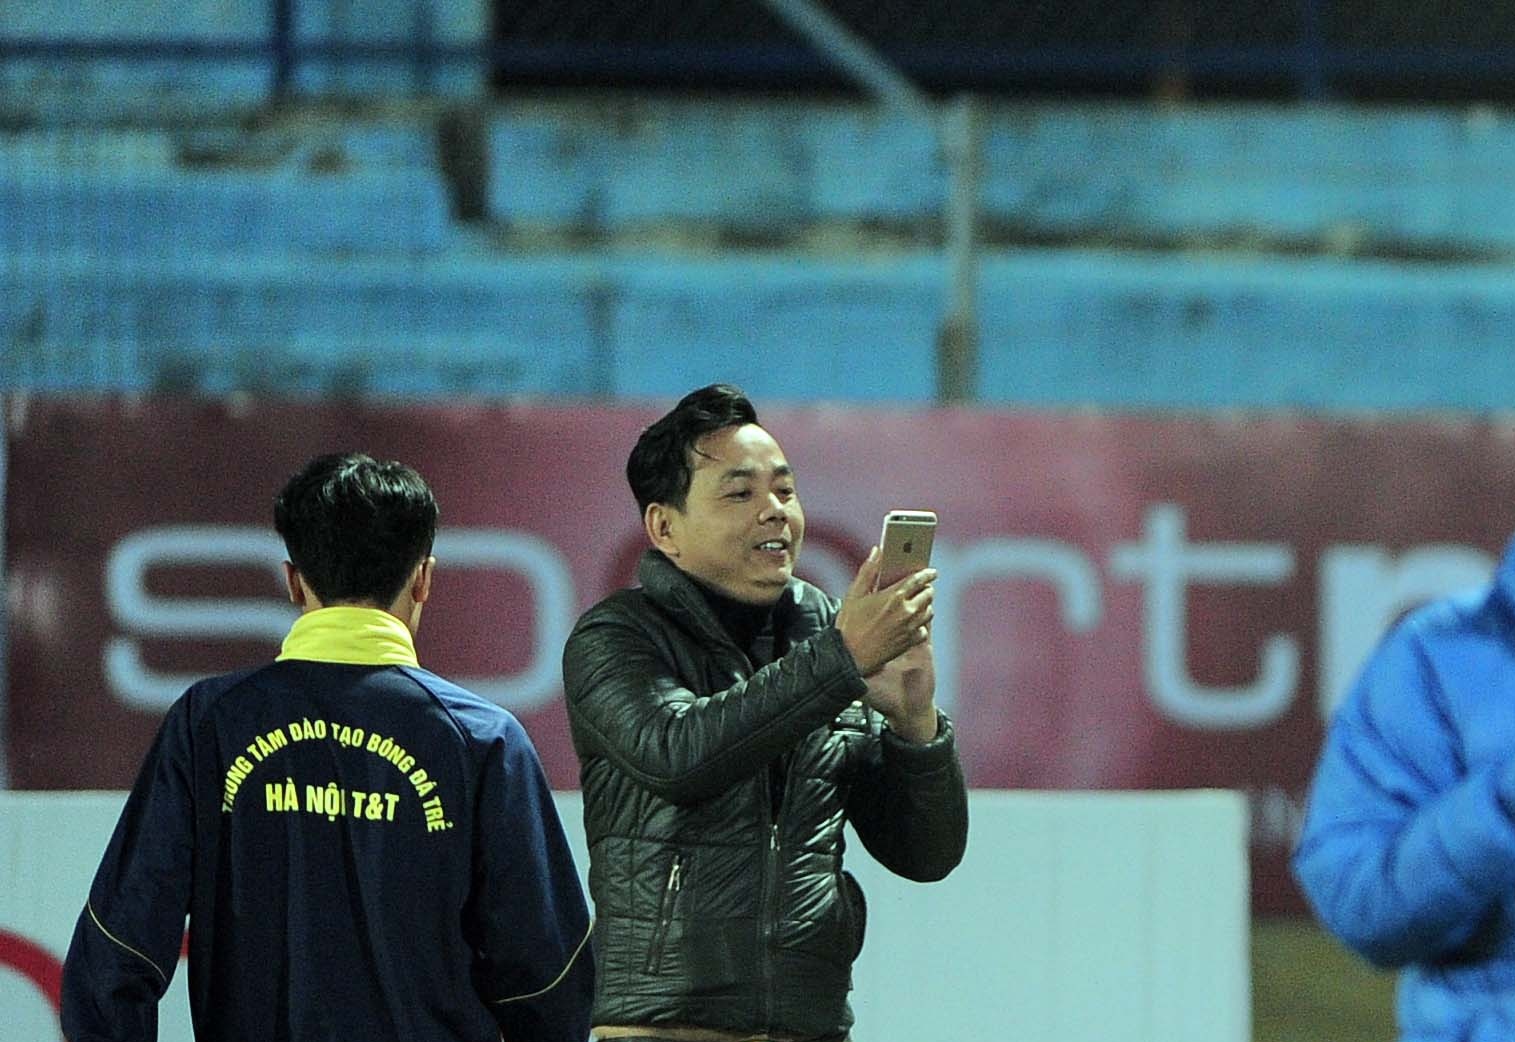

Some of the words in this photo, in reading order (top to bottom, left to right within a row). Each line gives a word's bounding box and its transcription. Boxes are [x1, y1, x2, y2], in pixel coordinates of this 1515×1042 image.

[247, 728, 288, 763] TÂM
[288, 717, 327, 743] ĐÀO
[330, 722, 365, 748] TẠO
[366, 734, 416, 774] BÓNG
[222, 756, 254, 813] TRUNG
[265, 776, 299, 812] HÀ
[306, 782, 346, 822] NỘI
[351, 791, 400, 822] T&T
[408, 768, 438, 797] ĐÁ
[422, 795, 455, 833] TRẺ
